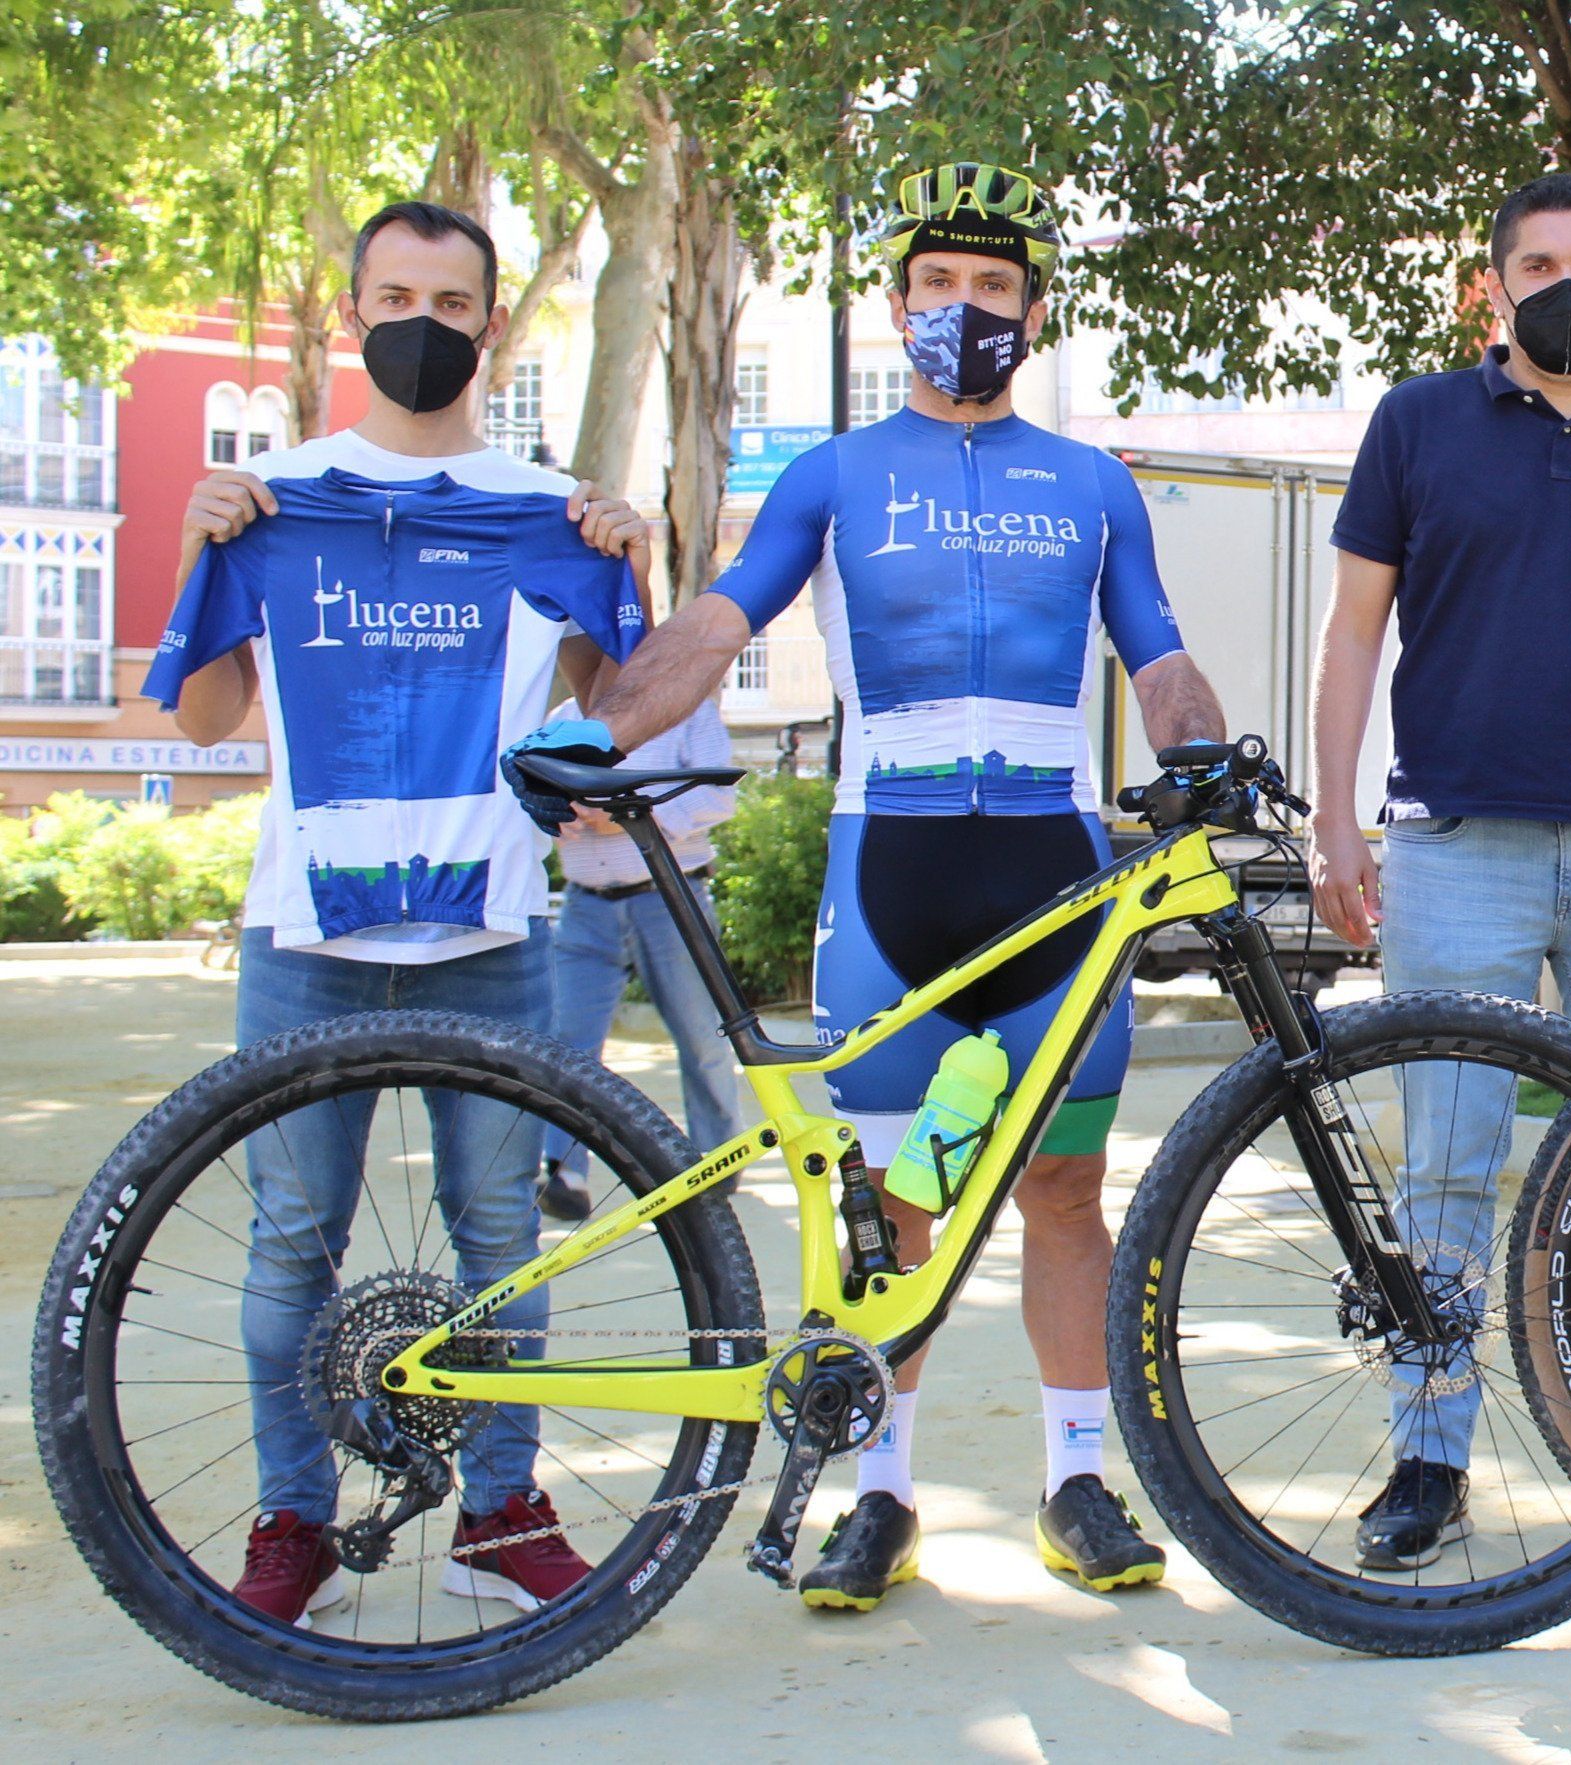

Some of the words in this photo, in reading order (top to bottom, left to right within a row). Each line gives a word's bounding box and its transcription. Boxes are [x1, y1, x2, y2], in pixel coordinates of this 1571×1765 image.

[929, 228, 945, 238] NO
[978, 337, 994, 350] BTT
[997, 331, 1014, 345] CAR
[999, 344, 1012, 356] MO
[923, 498, 1082, 543] lucena
[941, 535, 972, 550] con
[976, 535, 1002, 553] luz
[1007, 538, 1066, 558] propia
[346, 589, 483, 629] lucena
[362, 631, 388, 647] con
[391, 628, 414, 647] luz
[414, 629, 465, 652] propia
[686, 1144, 750, 1190] SRAM
[637, 1195, 668, 1217] MAXXIS
[61, 1183, 139, 1350] MAXXIS
[448, 1284, 517, 1334] hope
[1141, 1256, 1168, 1421] MAXXIS
